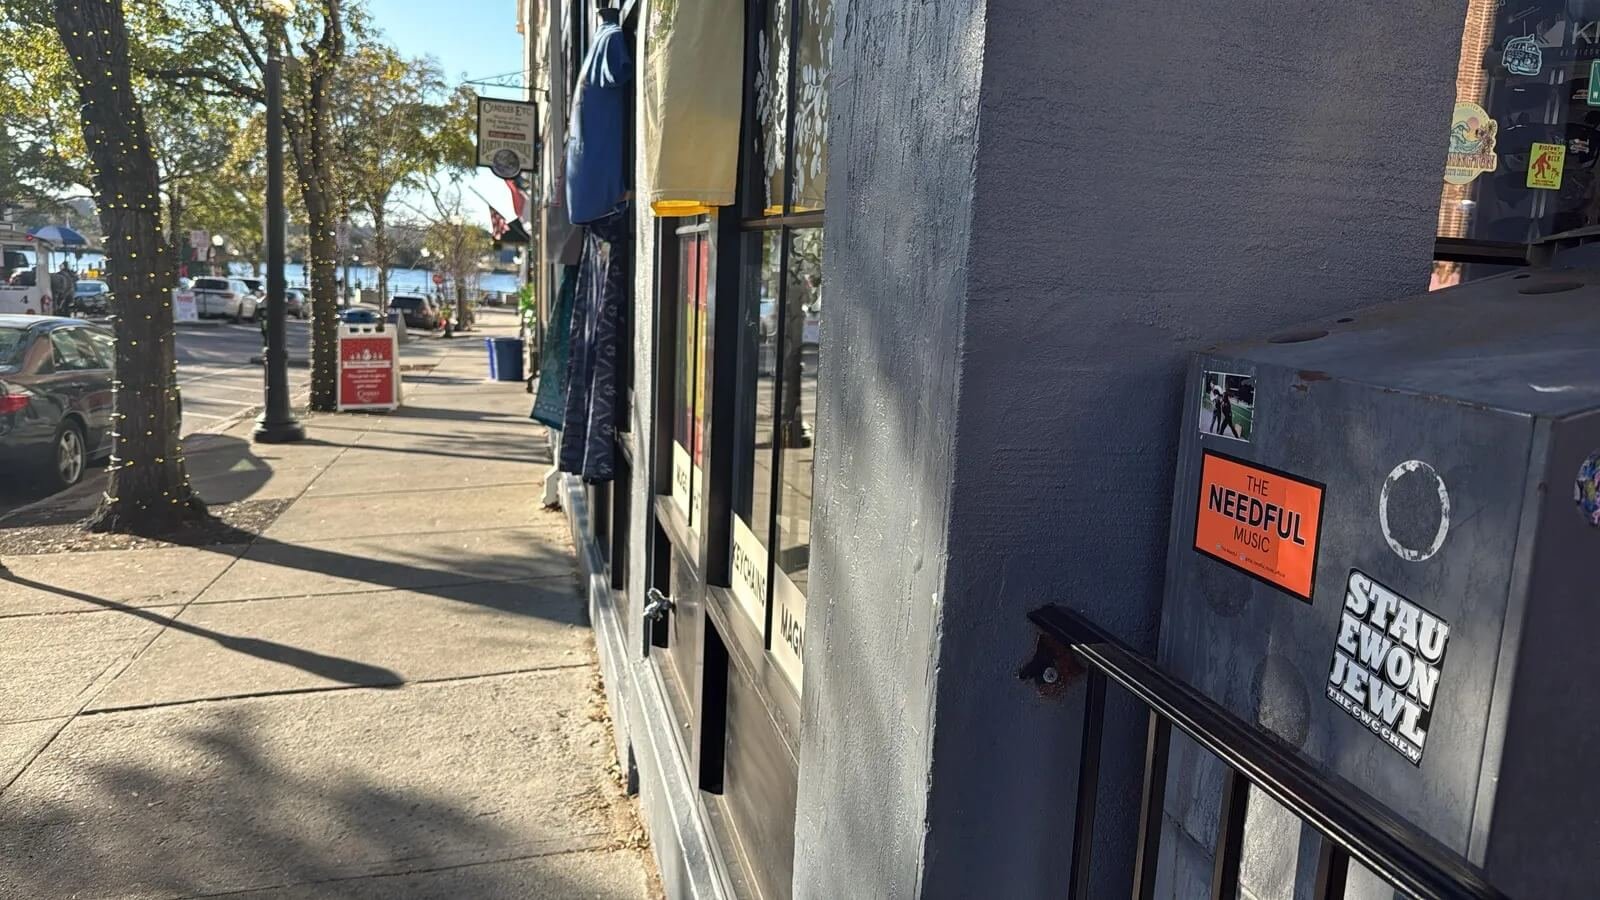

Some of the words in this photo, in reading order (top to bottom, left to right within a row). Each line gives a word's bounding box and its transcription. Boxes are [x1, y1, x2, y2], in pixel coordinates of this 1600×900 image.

[1208, 484, 1305, 546] NEEDFUL
[1246, 475, 1270, 497] THE
[733, 541, 765, 607] KEYCHAINS
[1233, 525, 1271, 553] MUSIC
[1345, 571, 1450, 662] STAU
[1337, 613, 1440, 708] EWON
[1327, 687, 1351, 710] THE
[1351, 705, 1380, 732] CWC
[1380, 728, 1420, 763] CREW
[1329, 652, 1426, 748] JEWL
